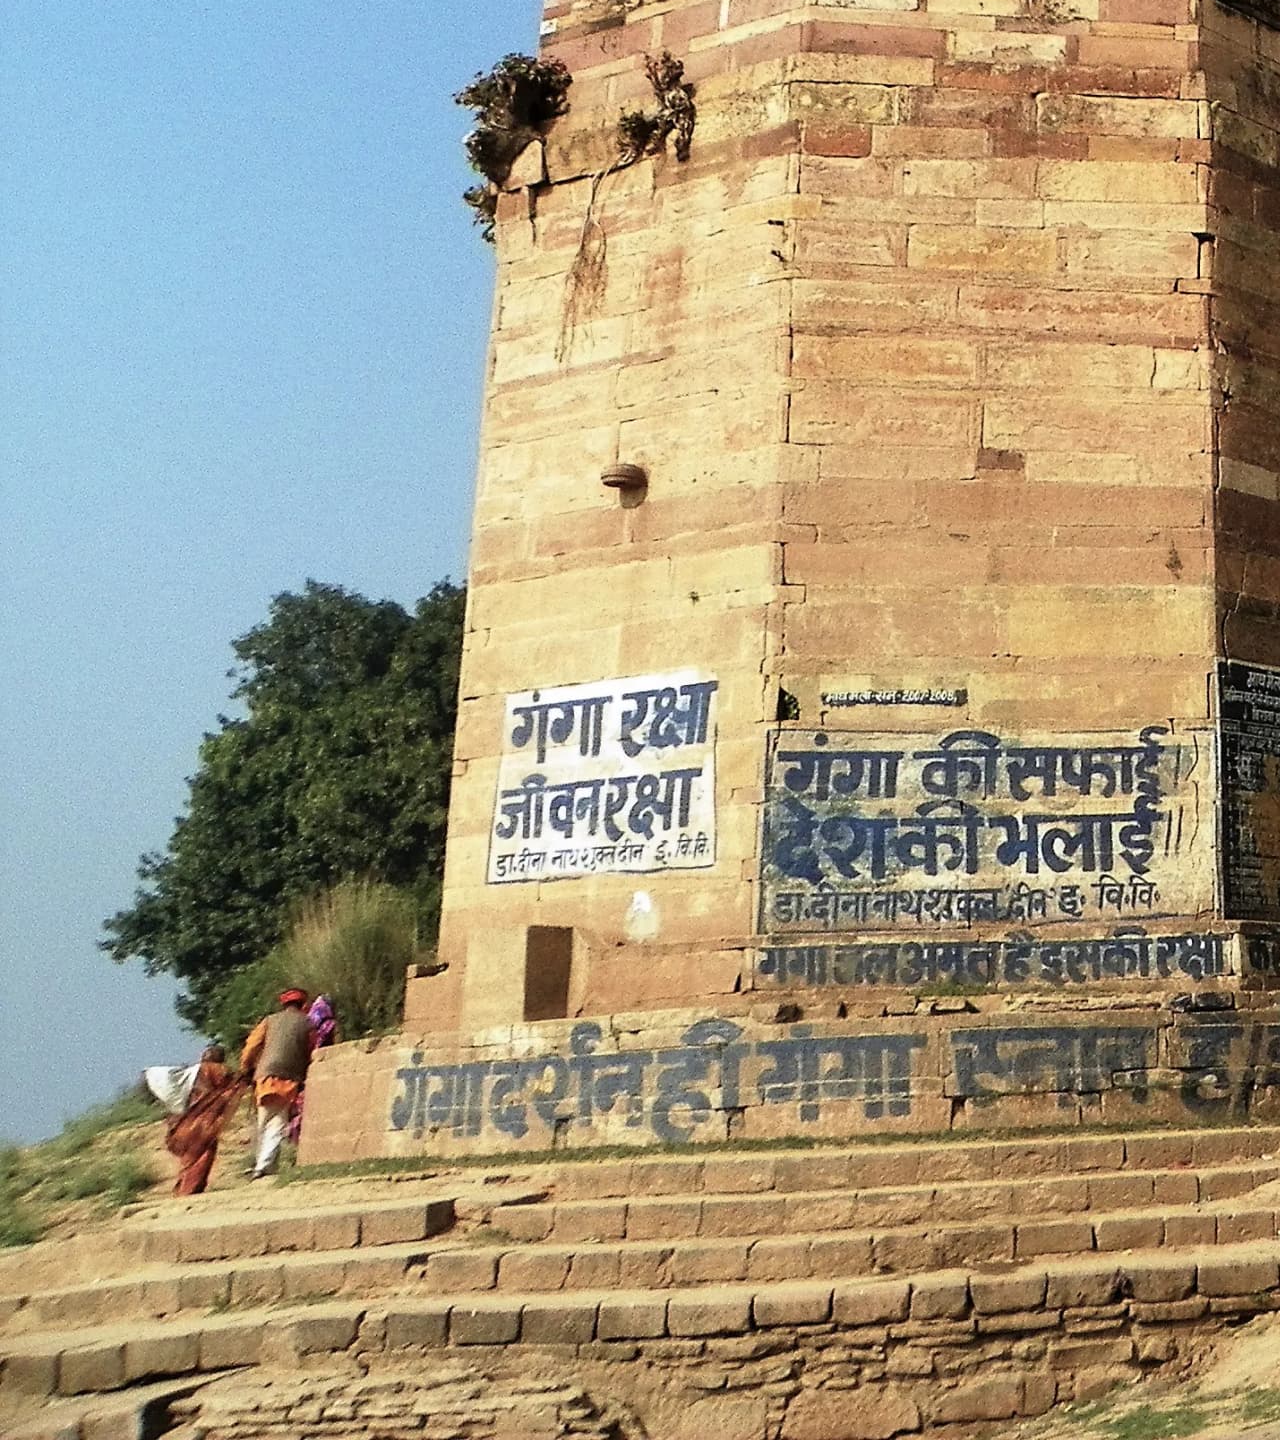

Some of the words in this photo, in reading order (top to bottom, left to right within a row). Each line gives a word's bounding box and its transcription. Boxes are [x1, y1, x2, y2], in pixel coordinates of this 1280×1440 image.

[511, 689, 613, 764] गंगा
[619, 679, 719, 758] रक्षा
[777, 733, 904, 801] गंगा
[913, 730, 1000, 800] की
